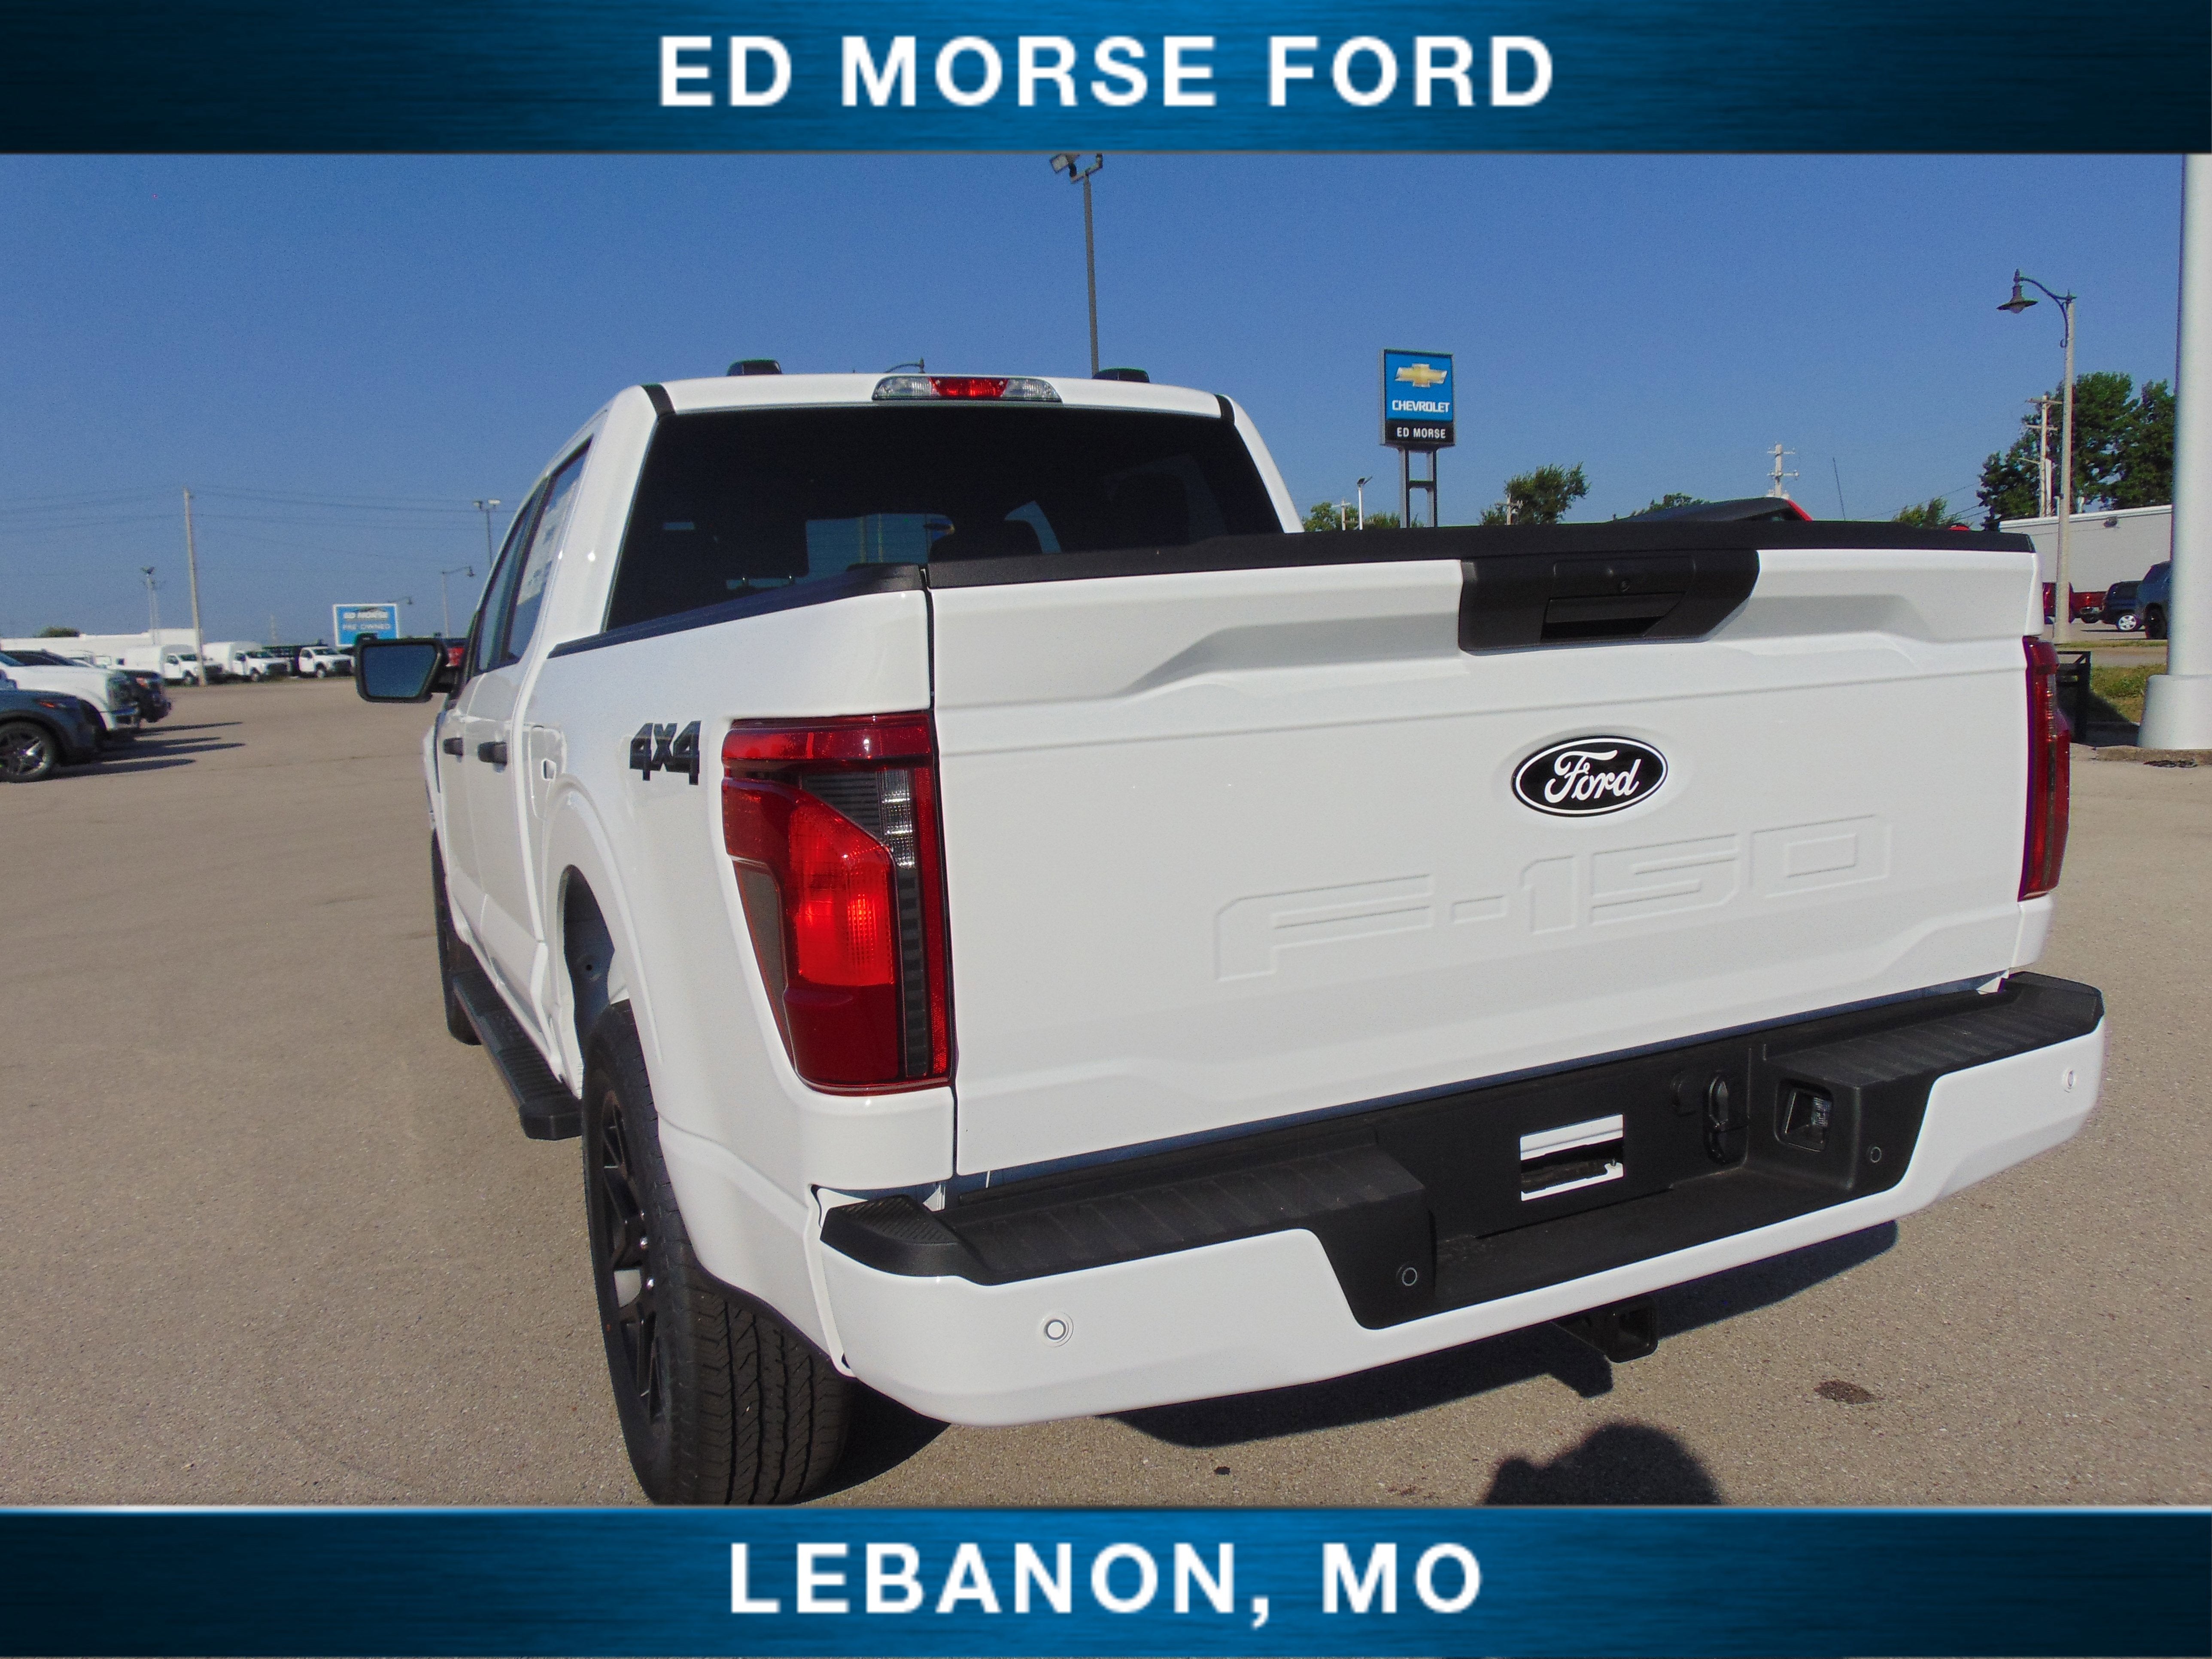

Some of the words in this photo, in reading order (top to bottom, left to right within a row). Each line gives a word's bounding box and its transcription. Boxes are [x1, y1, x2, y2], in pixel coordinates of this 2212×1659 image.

[1392, 400, 1450, 413] CHEVROLET
[1396, 427, 1410, 438] ED
[1413, 427, 1446, 439] MORSE
[1544, 749, 1642, 804] Ford
[1214, 814, 1893, 982] F-150
